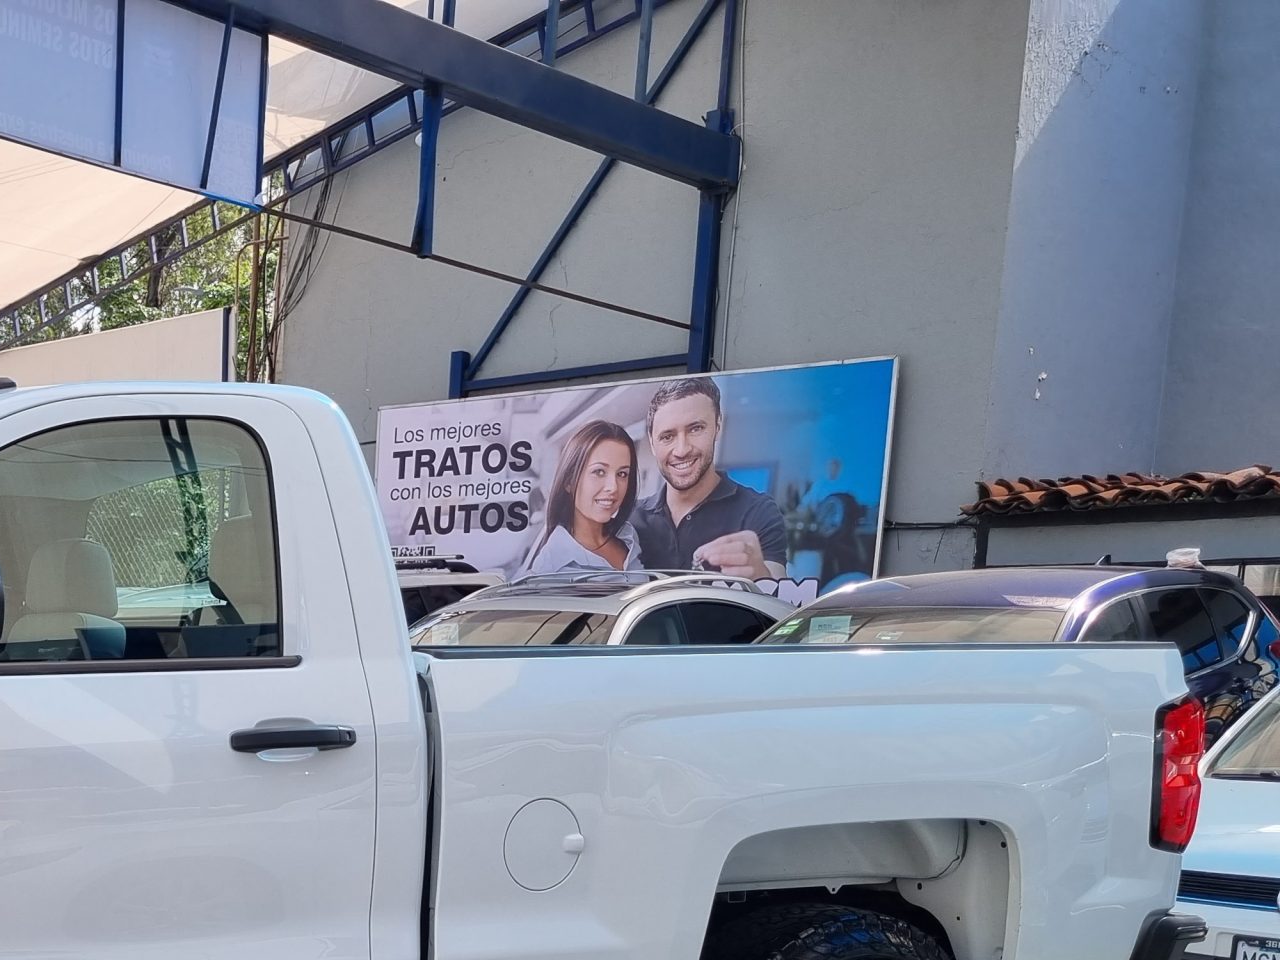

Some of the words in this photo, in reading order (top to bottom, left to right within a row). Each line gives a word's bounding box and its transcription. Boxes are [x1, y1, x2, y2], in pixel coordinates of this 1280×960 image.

[394, 427, 425, 444] Los
[430, 422, 502, 443] mejores
[393, 441, 532, 480] TRATOS
[390, 486, 421, 501] con
[427, 482, 452, 499] los
[458, 478, 532, 500] mejores
[408, 501, 529, 536] AUTOS
